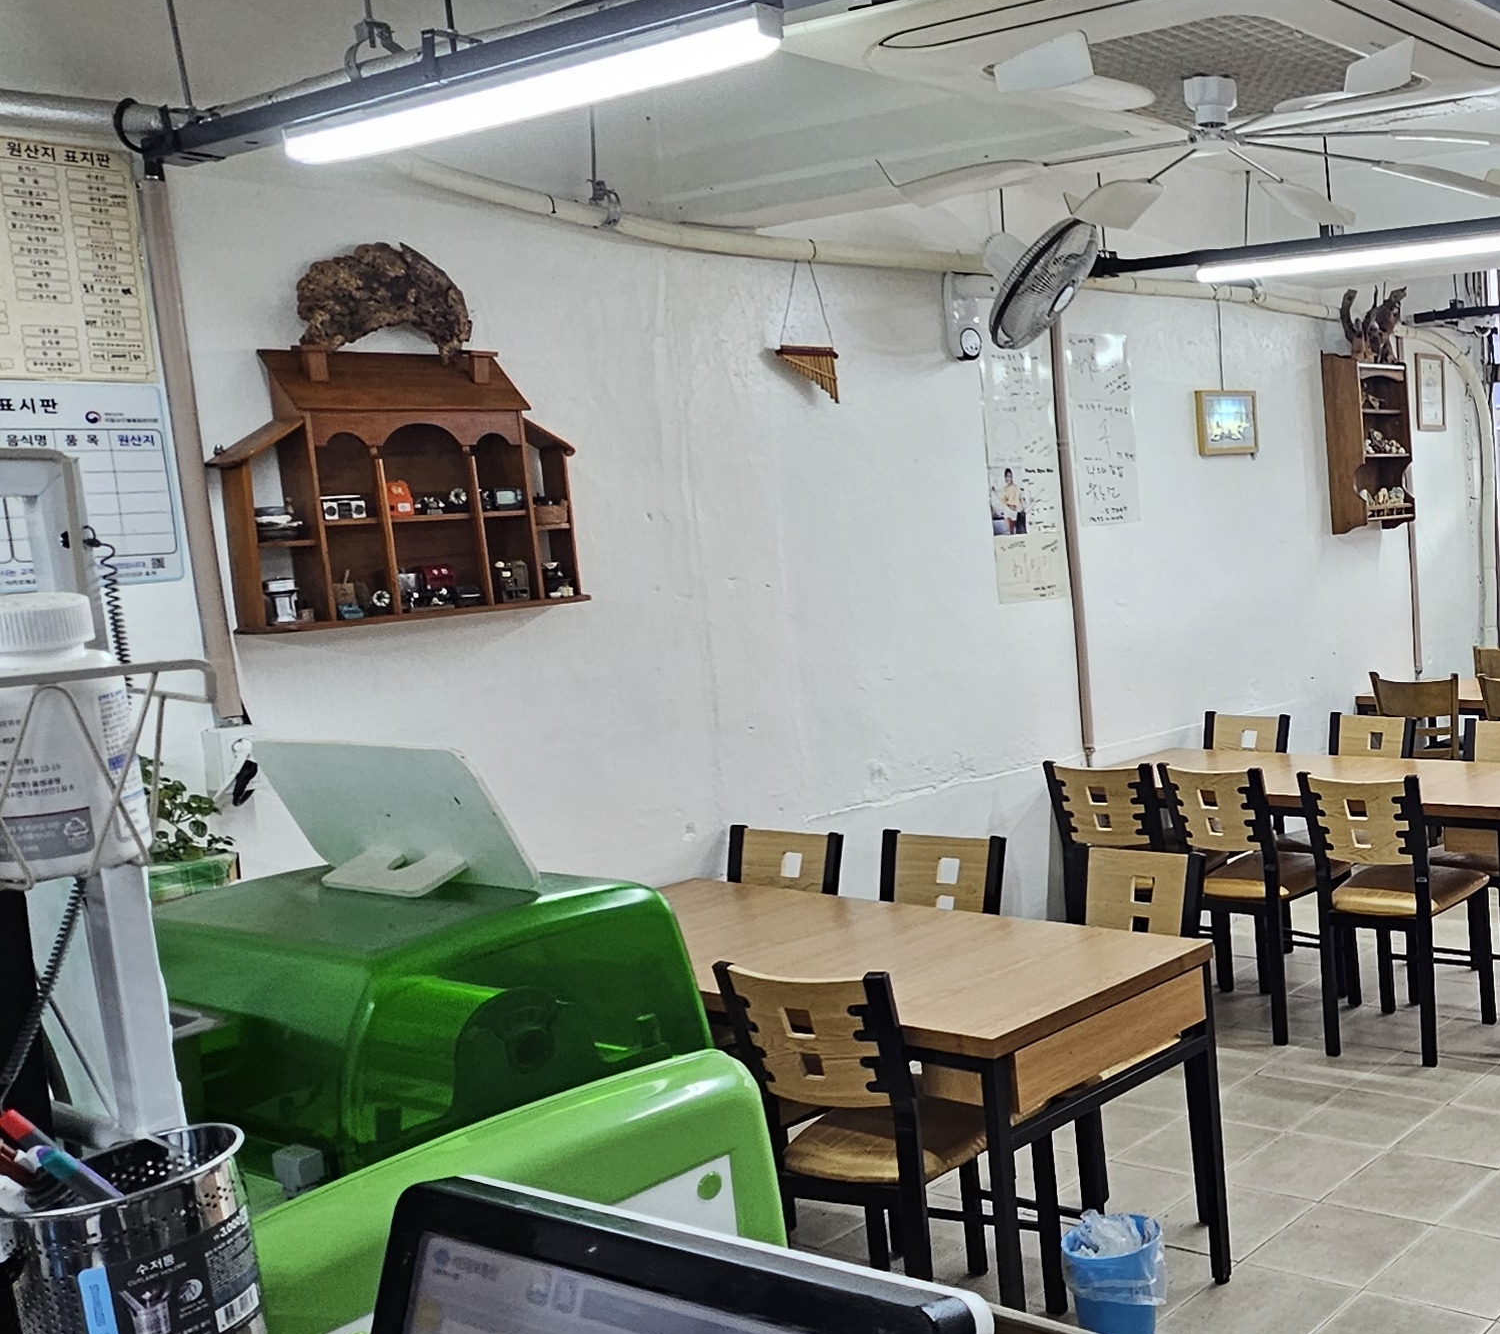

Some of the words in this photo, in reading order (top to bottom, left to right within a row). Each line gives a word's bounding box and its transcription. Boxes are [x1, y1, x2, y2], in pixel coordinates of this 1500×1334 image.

[6, 141, 56, 161] 원산지
[63, 149, 111, 169] 표지판
[0, 398, 58, 415] 표시판
[6, 434, 47, 447] 음식명
[117, 434, 156, 447] 원산지
